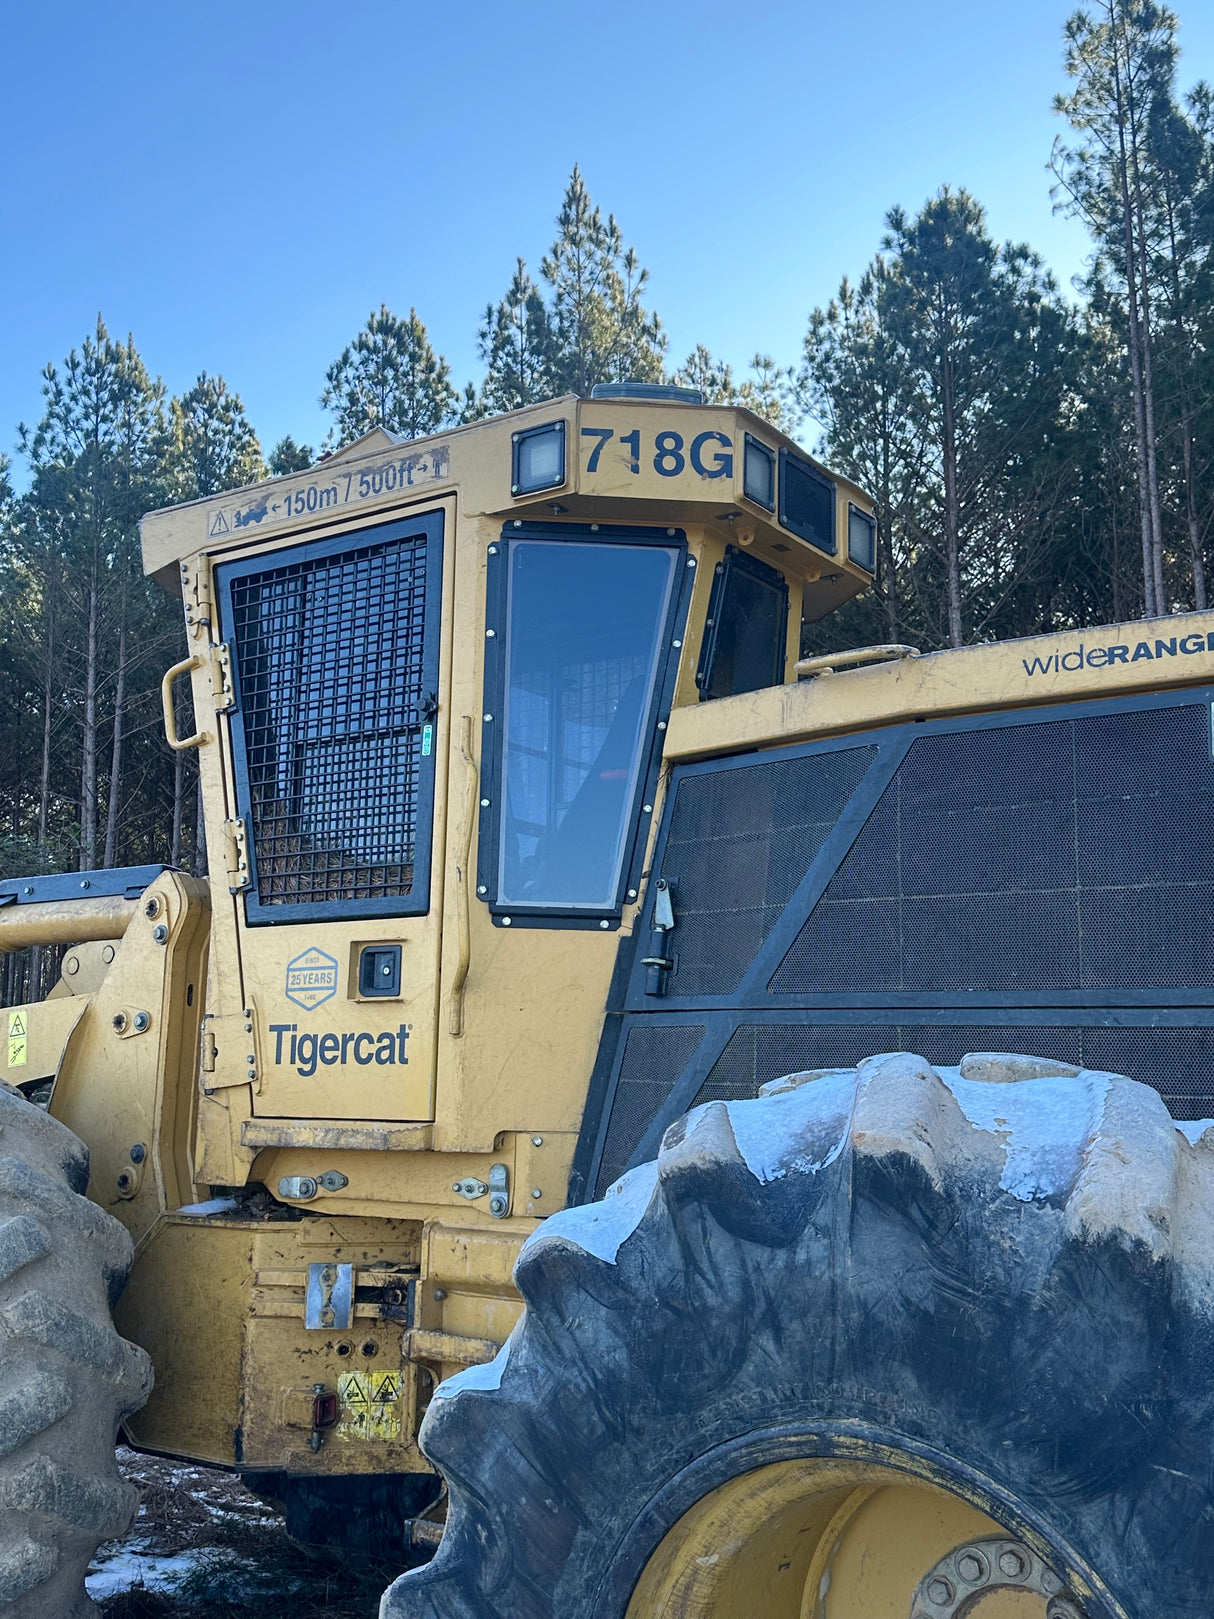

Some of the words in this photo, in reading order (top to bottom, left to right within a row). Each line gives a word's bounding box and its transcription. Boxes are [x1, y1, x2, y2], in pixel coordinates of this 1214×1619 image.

[581, 428, 733, 479] 718G
[284, 486, 338, 516] 150m
[358, 460, 414, 498] 500ft
[291, 974, 301, 985] 25
[303, 973, 332, 985] YEARS
[269, 1024, 409, 1077] Tigercat
